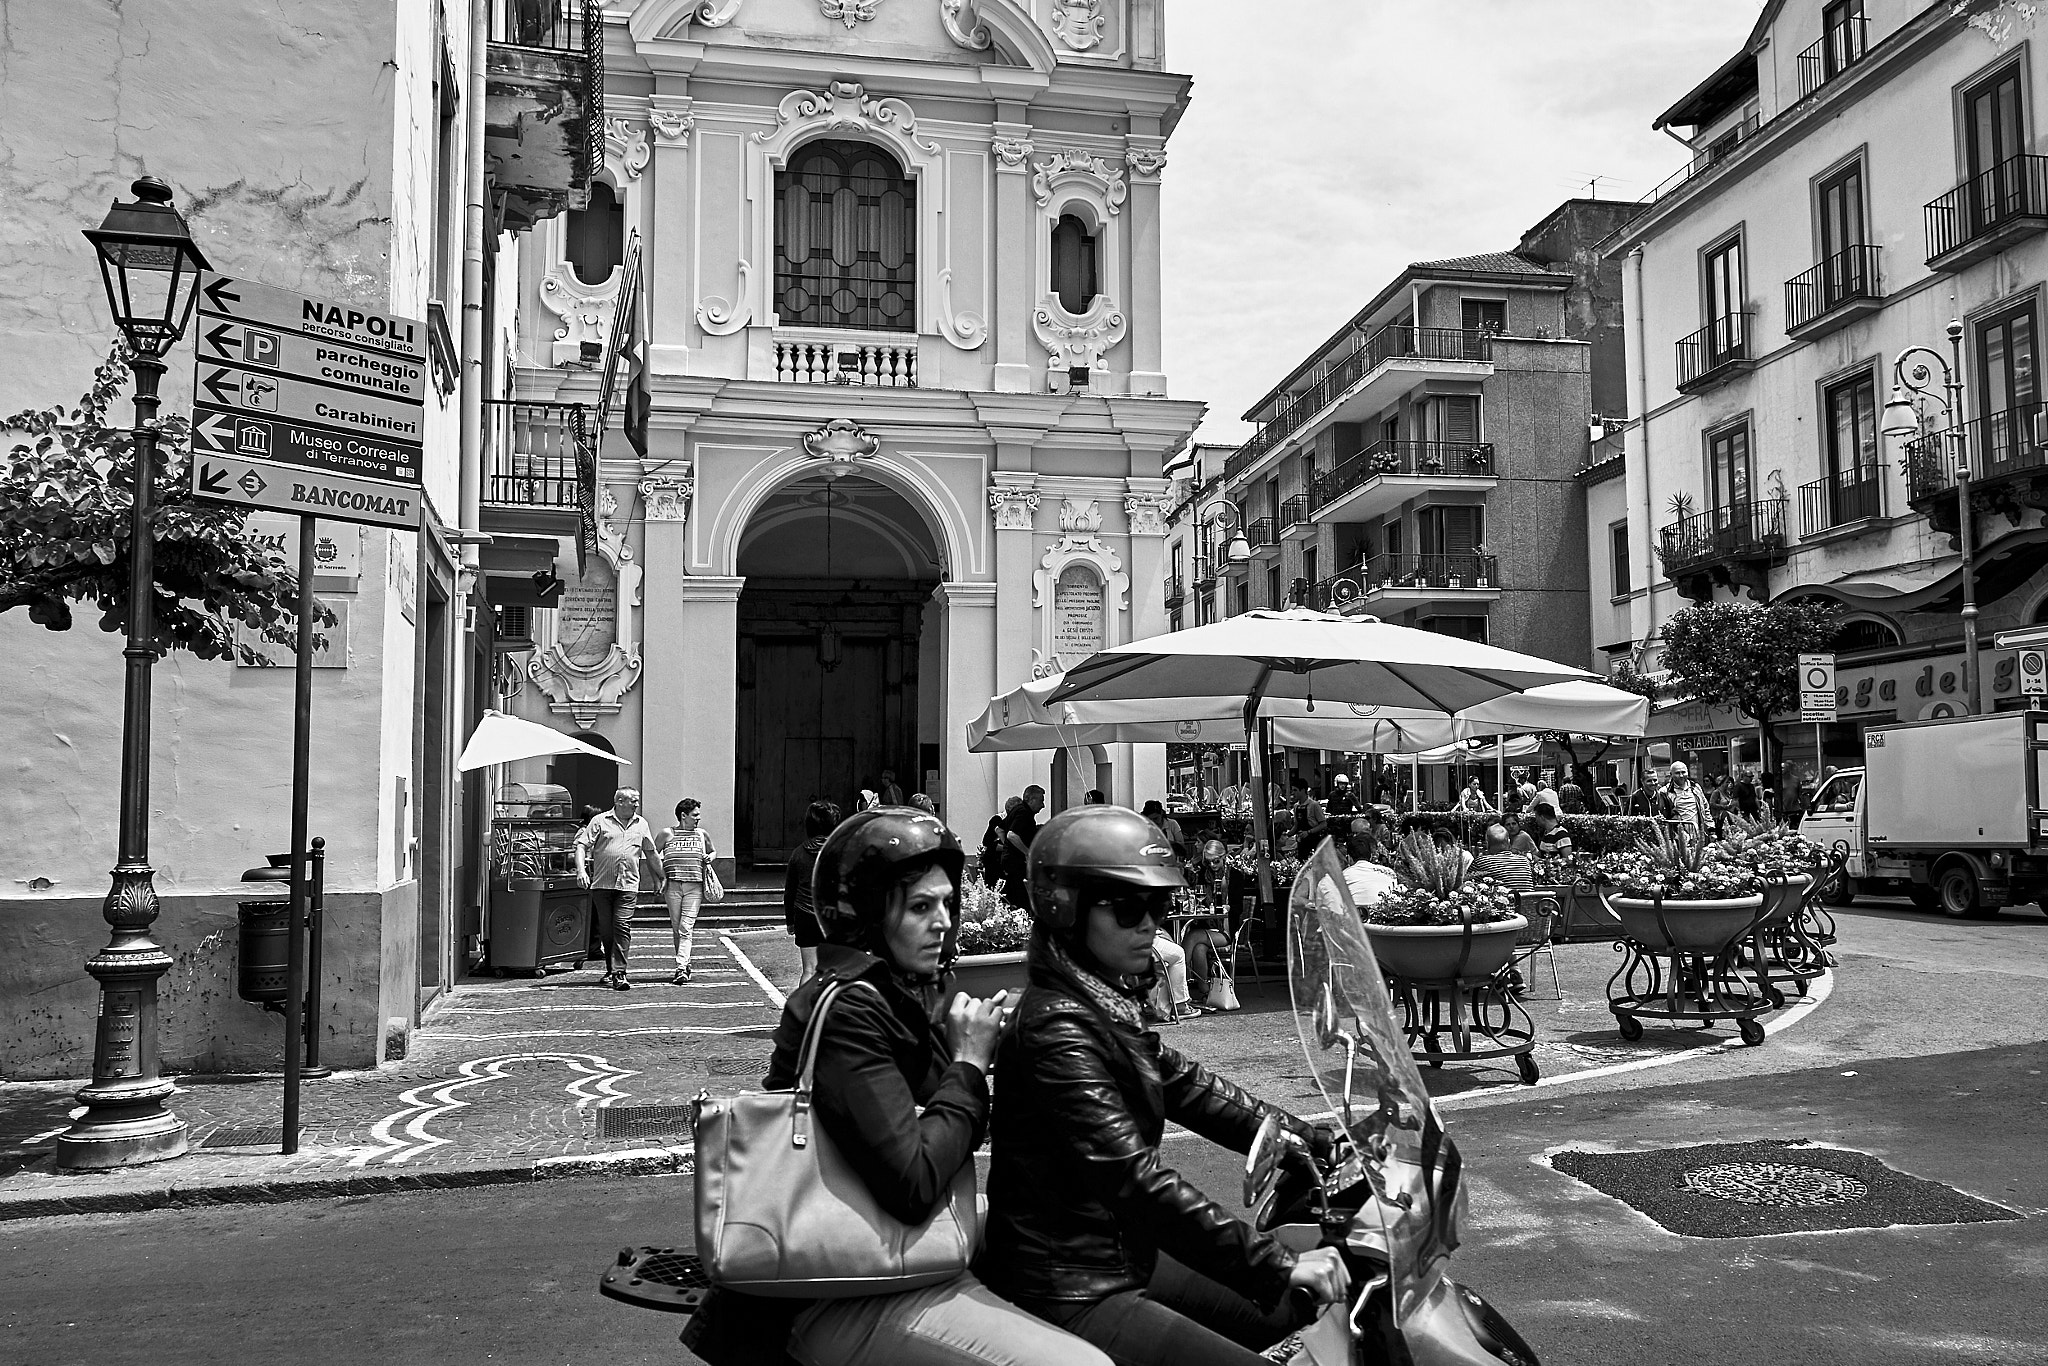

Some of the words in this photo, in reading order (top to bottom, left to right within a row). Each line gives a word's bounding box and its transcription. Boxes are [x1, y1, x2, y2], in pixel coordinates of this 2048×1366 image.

[302, 299, 414, 343] NAPOLI
[253, 335, 274, 360] P
[302, 322, 352, 341] percorso
[354, 334, 414, 353] consigliato
[316, 347, 419, 379] parcheggio
[321, 366, 411, 394] comunale
[315, 402, 416, 434] Carabinieri
[290, 429, 342, 451] Museo
[347, 440, 410, 464] Correale
[305, 449, 319, 460] di
[321, 450, 388, 472] Terranova
[290, 483, 410, 516] BANCOMAT
[1836, 676, 1896, 708] ega
[1915, 660, 1968, 698] del
[1993, 656, 2015, 693] g
[1676, 735, 1727, 750] RESTAURAN
